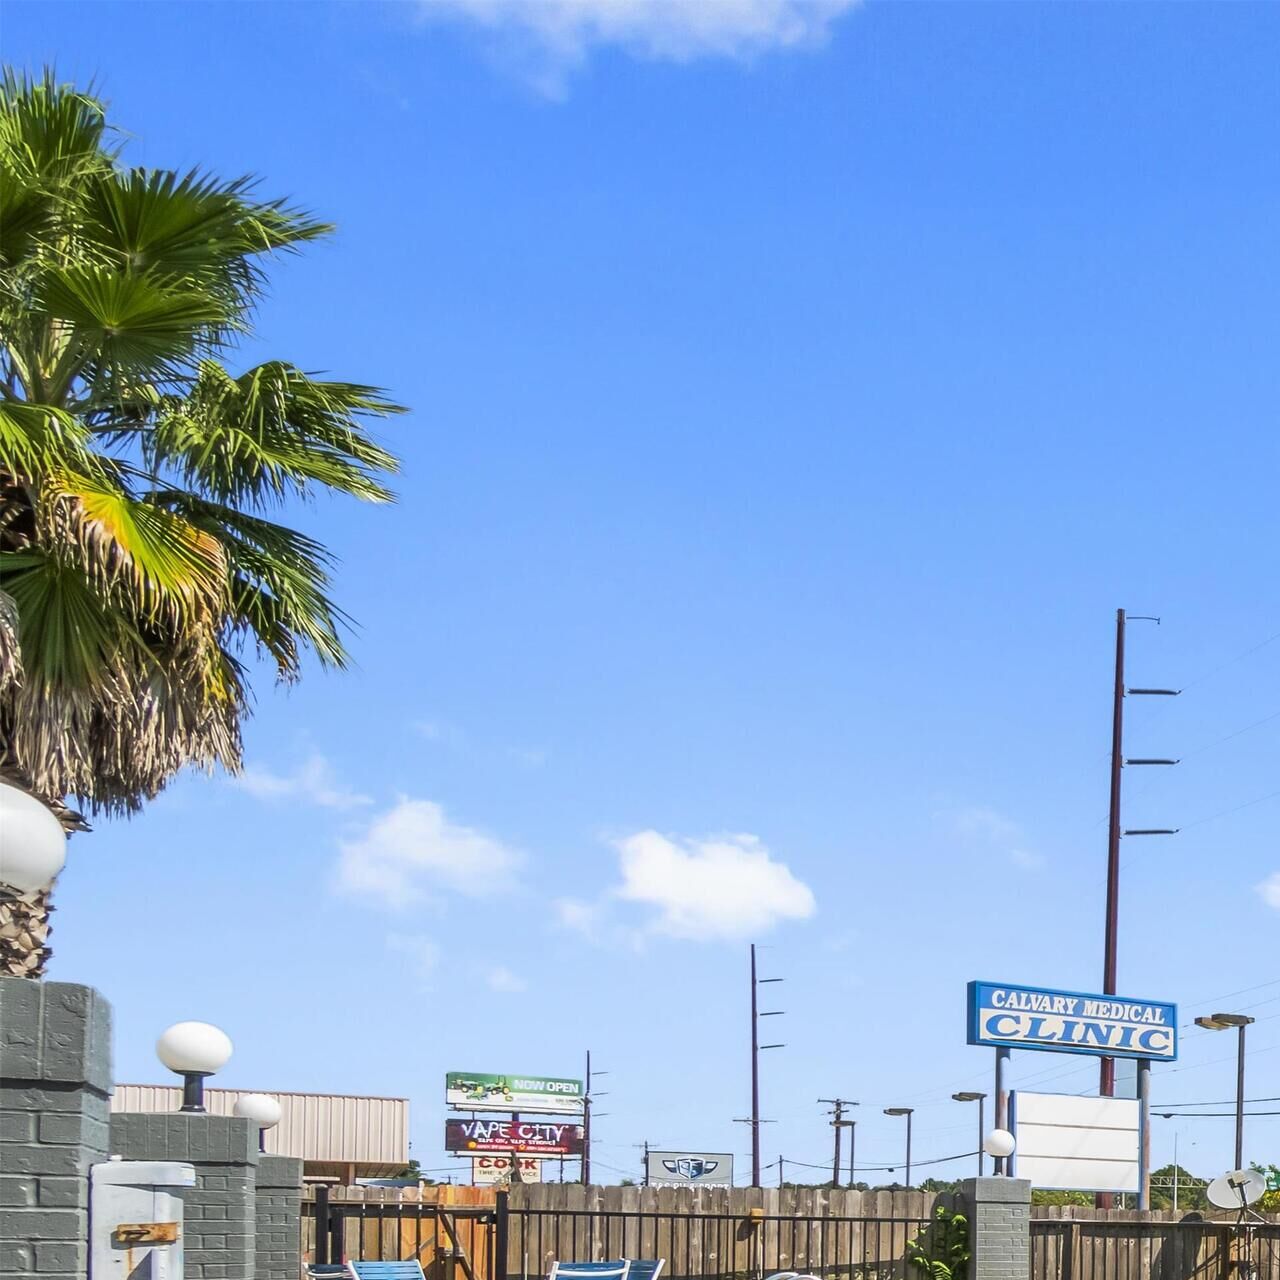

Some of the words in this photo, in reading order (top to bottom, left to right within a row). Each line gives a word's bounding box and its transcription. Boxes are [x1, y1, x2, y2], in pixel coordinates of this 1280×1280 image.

[992, 990, 1078, 1015] CALVARY
[1083, 1000, 1165, 1024] MEDICAL
[985, 1014, 1170, 1050] CLINIC
[513, 1080, 545, 1091] NOW
[546, 1082, 579, 1093] OPEN
[461, 1121, 512, 1139] VAPE
[518, 1124, 569, 1142] CITY
